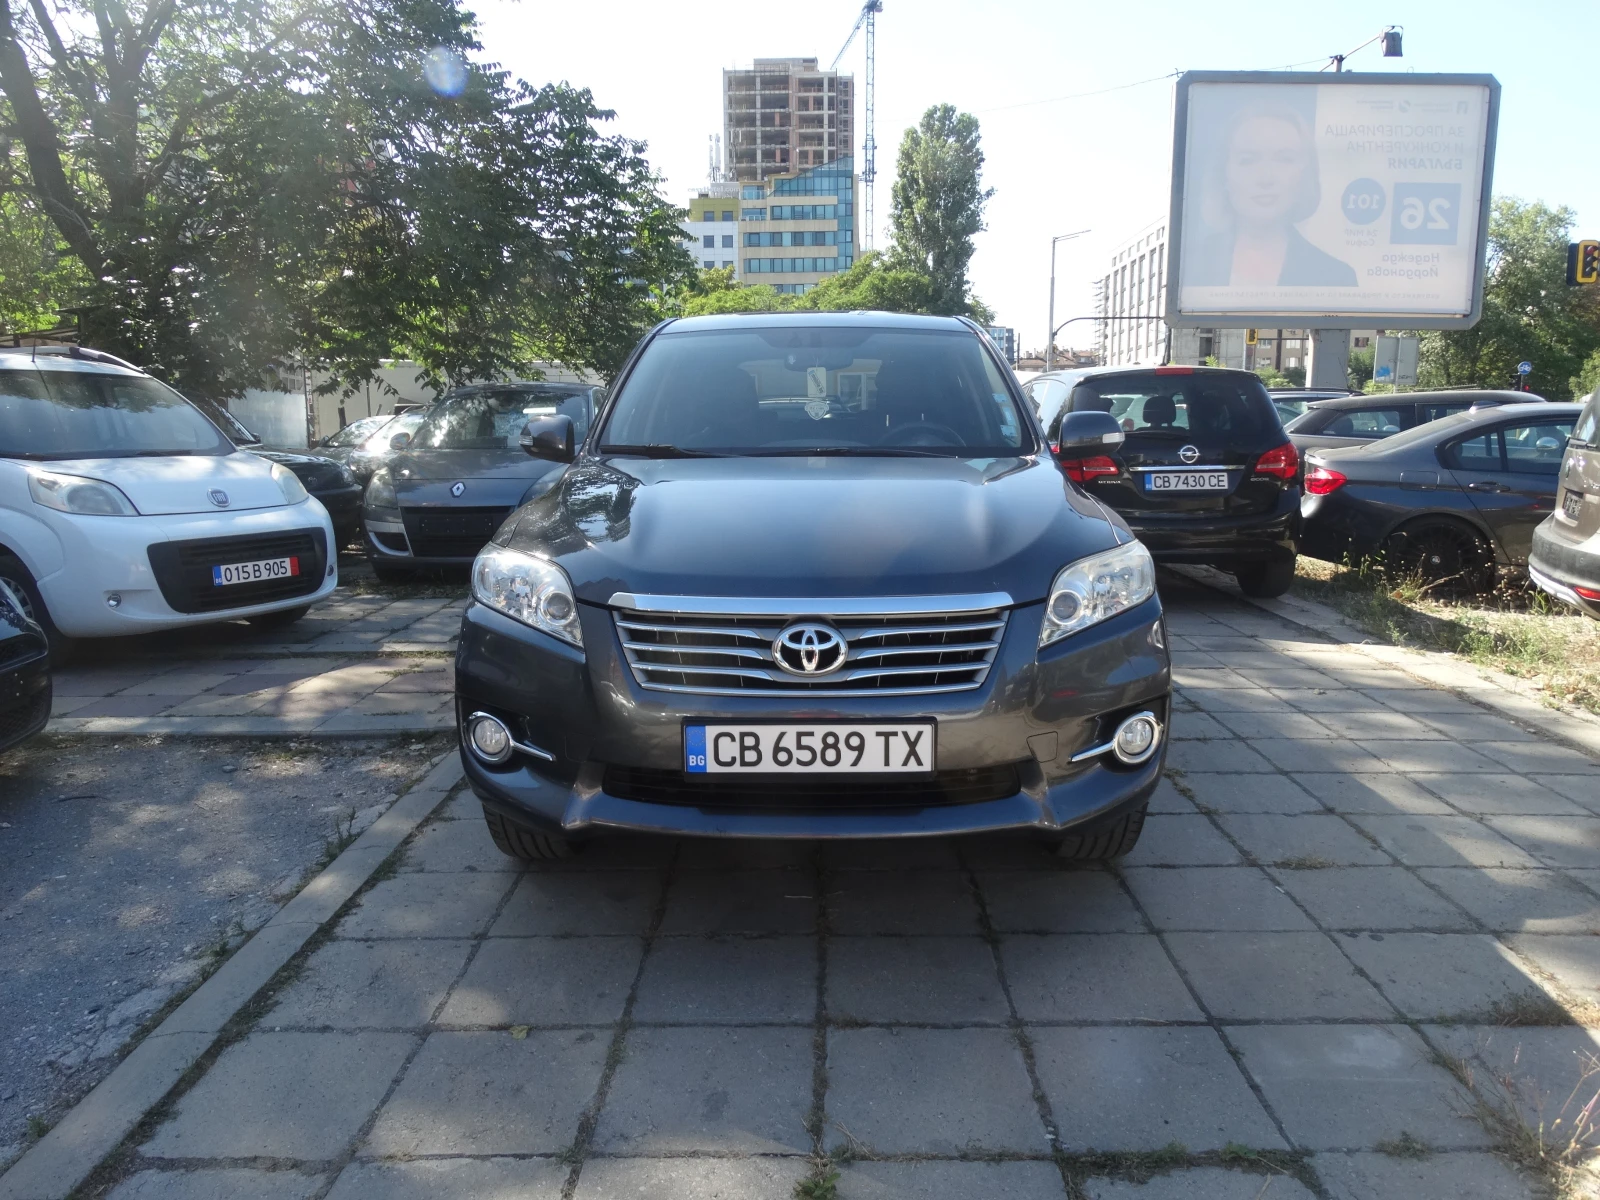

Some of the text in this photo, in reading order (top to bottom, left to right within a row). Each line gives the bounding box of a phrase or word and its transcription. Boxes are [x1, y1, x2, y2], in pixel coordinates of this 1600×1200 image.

[1153, 474, 1226, 489] CB 7430 CE
[713, 730, 924, 767] CB 6589 TX
[689, 755, 705, 766] BG
